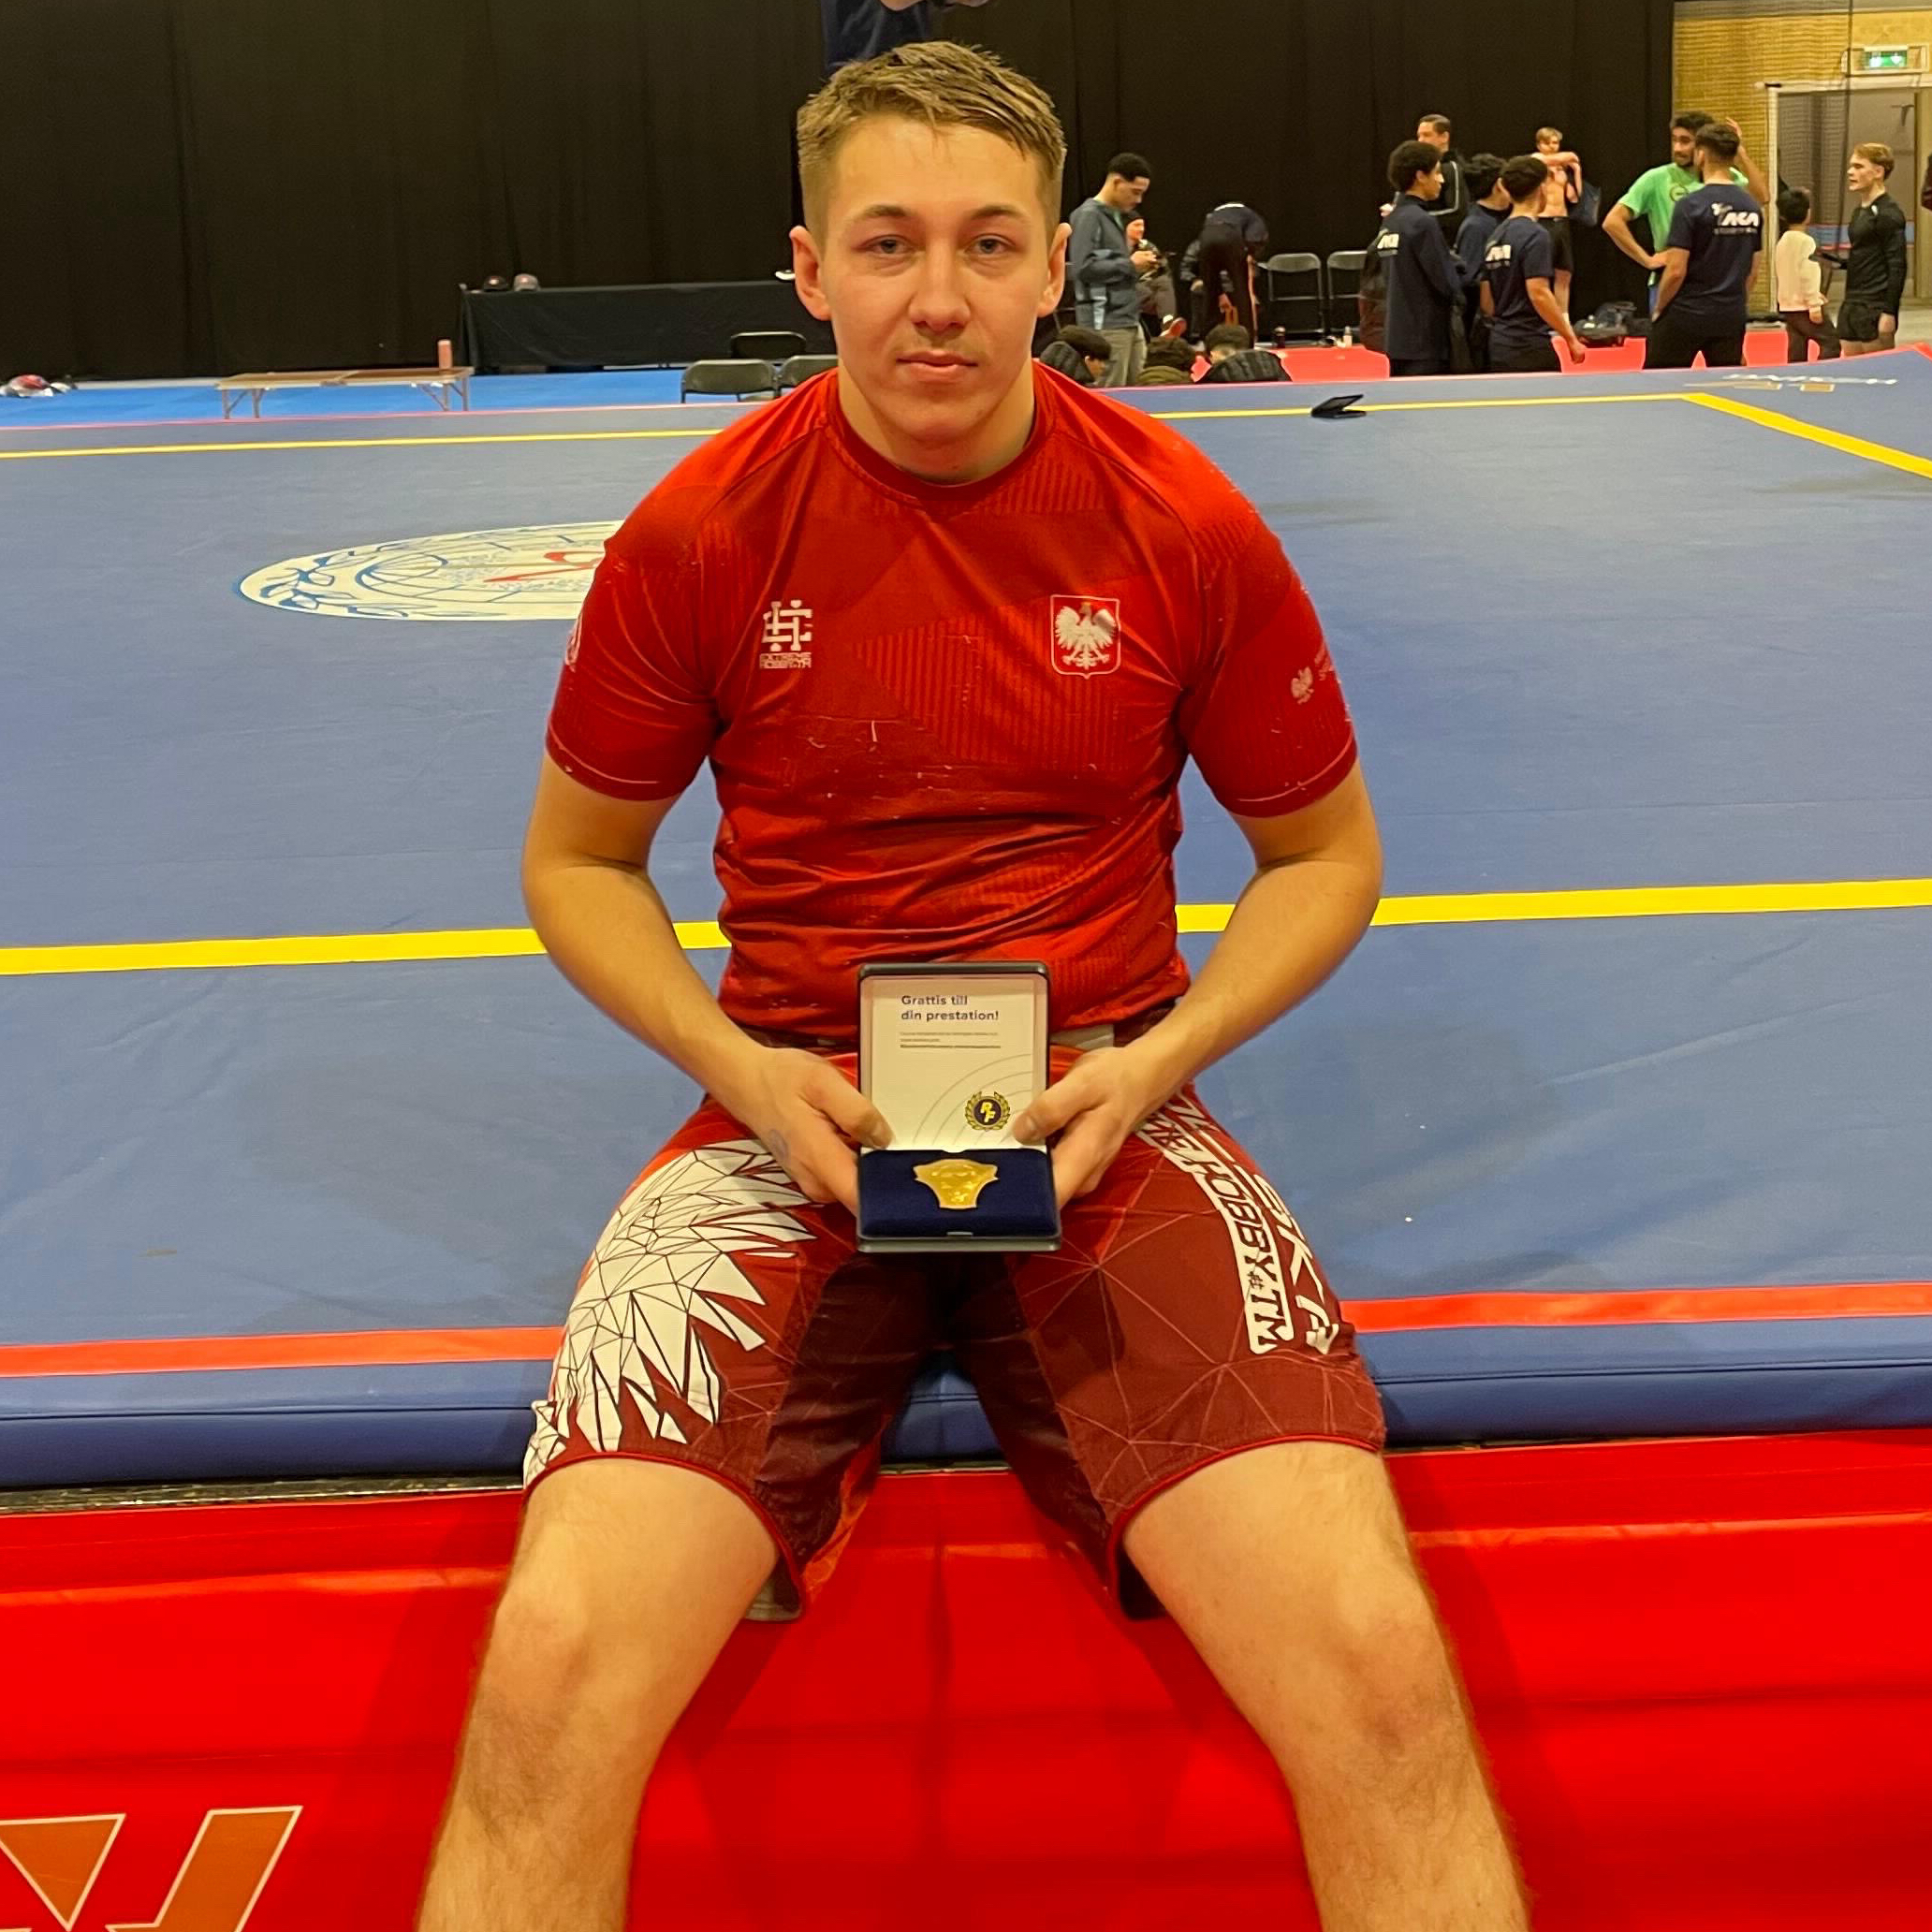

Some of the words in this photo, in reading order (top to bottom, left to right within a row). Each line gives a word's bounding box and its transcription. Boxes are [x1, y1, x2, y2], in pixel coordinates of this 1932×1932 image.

[900, 994, 946, 1005] Grattis
[951, 994, 968, 1005] till
[900, 1010, 922, 1020] din
[926, 1010, 999, 1022] prestation!
